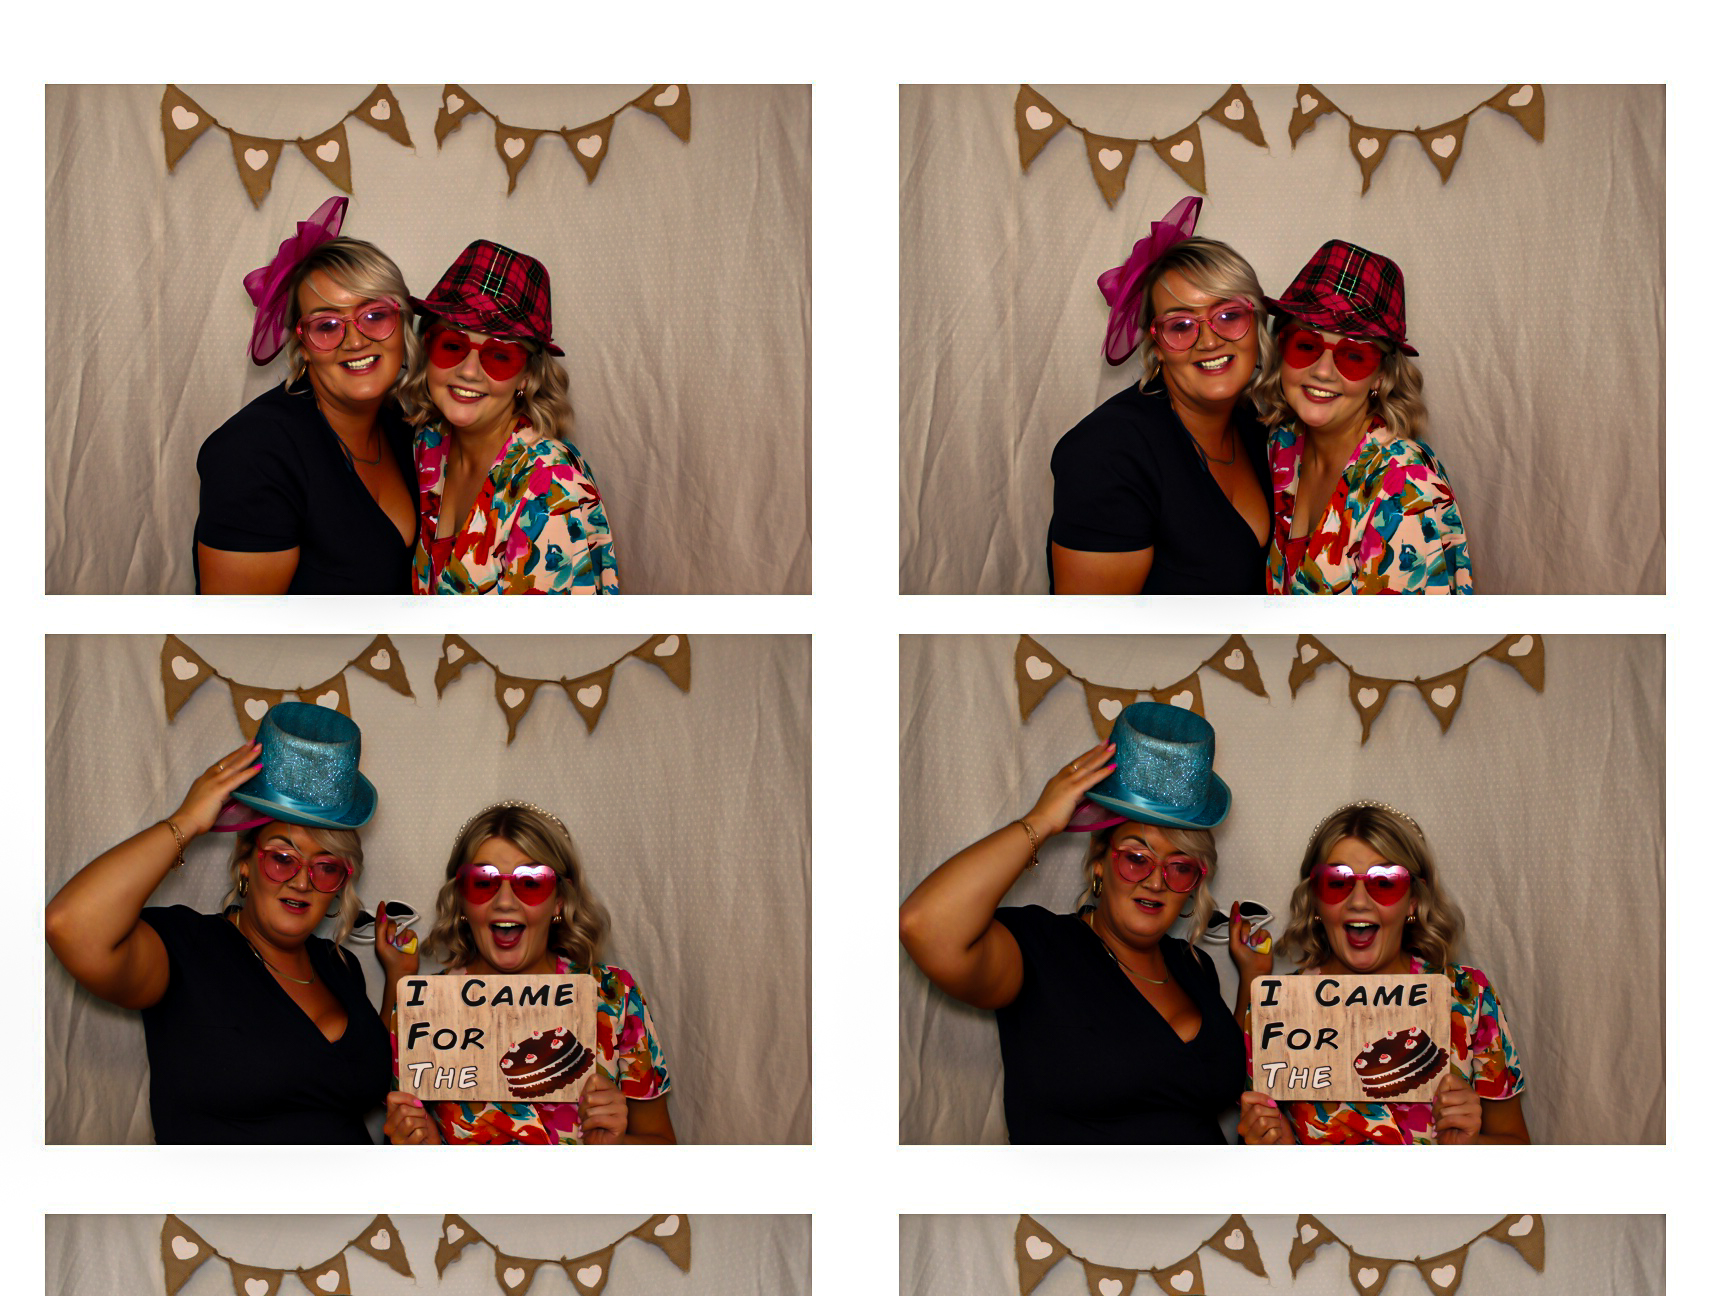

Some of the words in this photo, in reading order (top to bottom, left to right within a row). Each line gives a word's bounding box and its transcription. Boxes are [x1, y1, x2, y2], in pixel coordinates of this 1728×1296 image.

[406, 980, 428, 1007] I
[461, 979, 574, 1007] CAME
[1260, 980, 1282, 1007] I
[1315, 979, 1428, 1007] CAME
[407, 1022, 485, 1050] FOR
[1261, 1022, 1339, 1050] FOR
[407, 1062, 478, 1090] THE
[1261, 1062, 1332, 1090] THE
